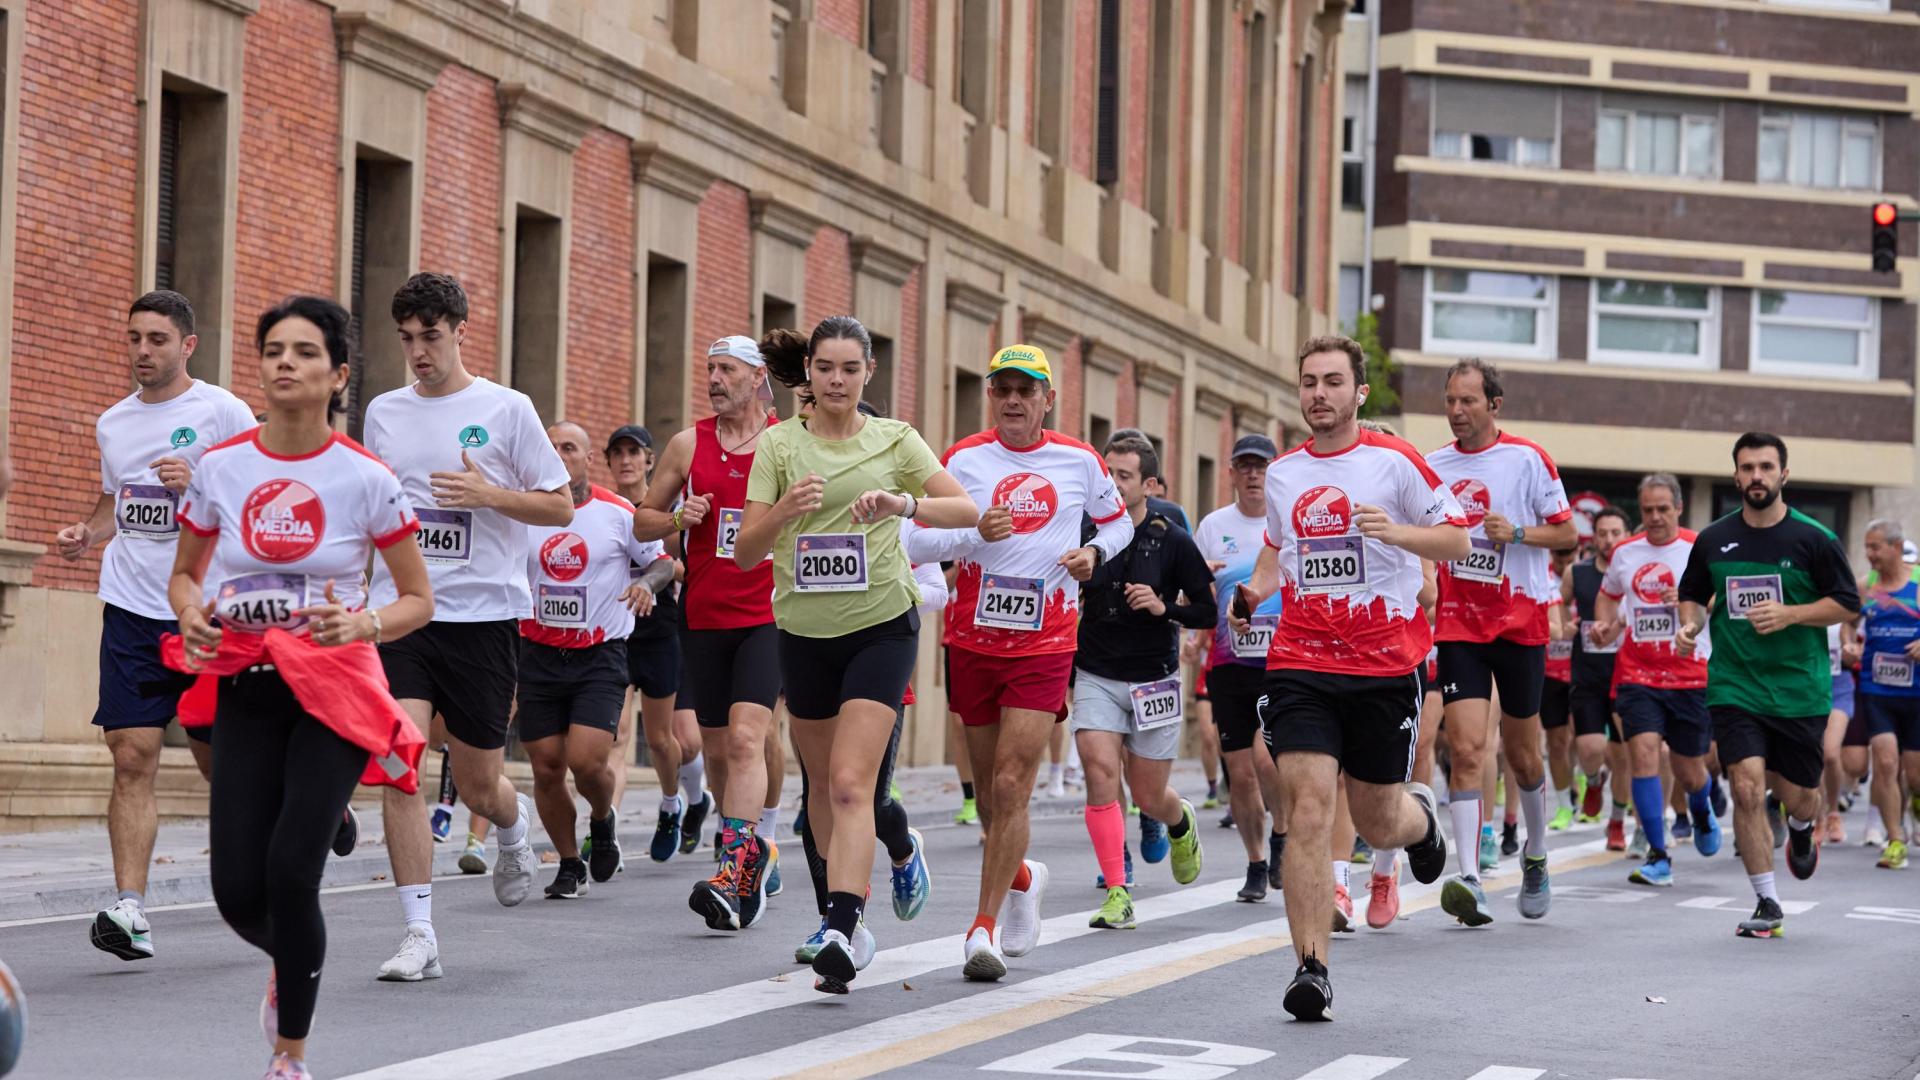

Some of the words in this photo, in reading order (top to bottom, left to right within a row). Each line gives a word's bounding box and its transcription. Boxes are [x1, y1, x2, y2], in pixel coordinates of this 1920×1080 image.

[1017, 490, 1035, 501] LA
[126, 503, 169, 525] 21021
[271, 505, 295, 520] LA
[1004, 500, 1049, 512] MEDIA
[1312, 504, 1331, 515] LA
[1463, 501, 1485, 511] EDIA
[255, 518, 315, 536] MEDIA
[1302, 514, 1343, 528] MEDIA
[415, 528, 461, 550] 21461
[557, 547, 572, 556] LA
[548, 555, 582, 565] MEDIA
[802, 555, 858, 577] 21080
[1304, 556, 1357, 579] 21380
[228, 598, 290, 624] 21413
[544, 599, 578, 616] 21160
[985, 593, 1035, 616] 21475
[1639, 618, 1670, 632] 21439
[1237, 630, 1272, 646] 21071
[1143, 695, 1175, 717] 21319
